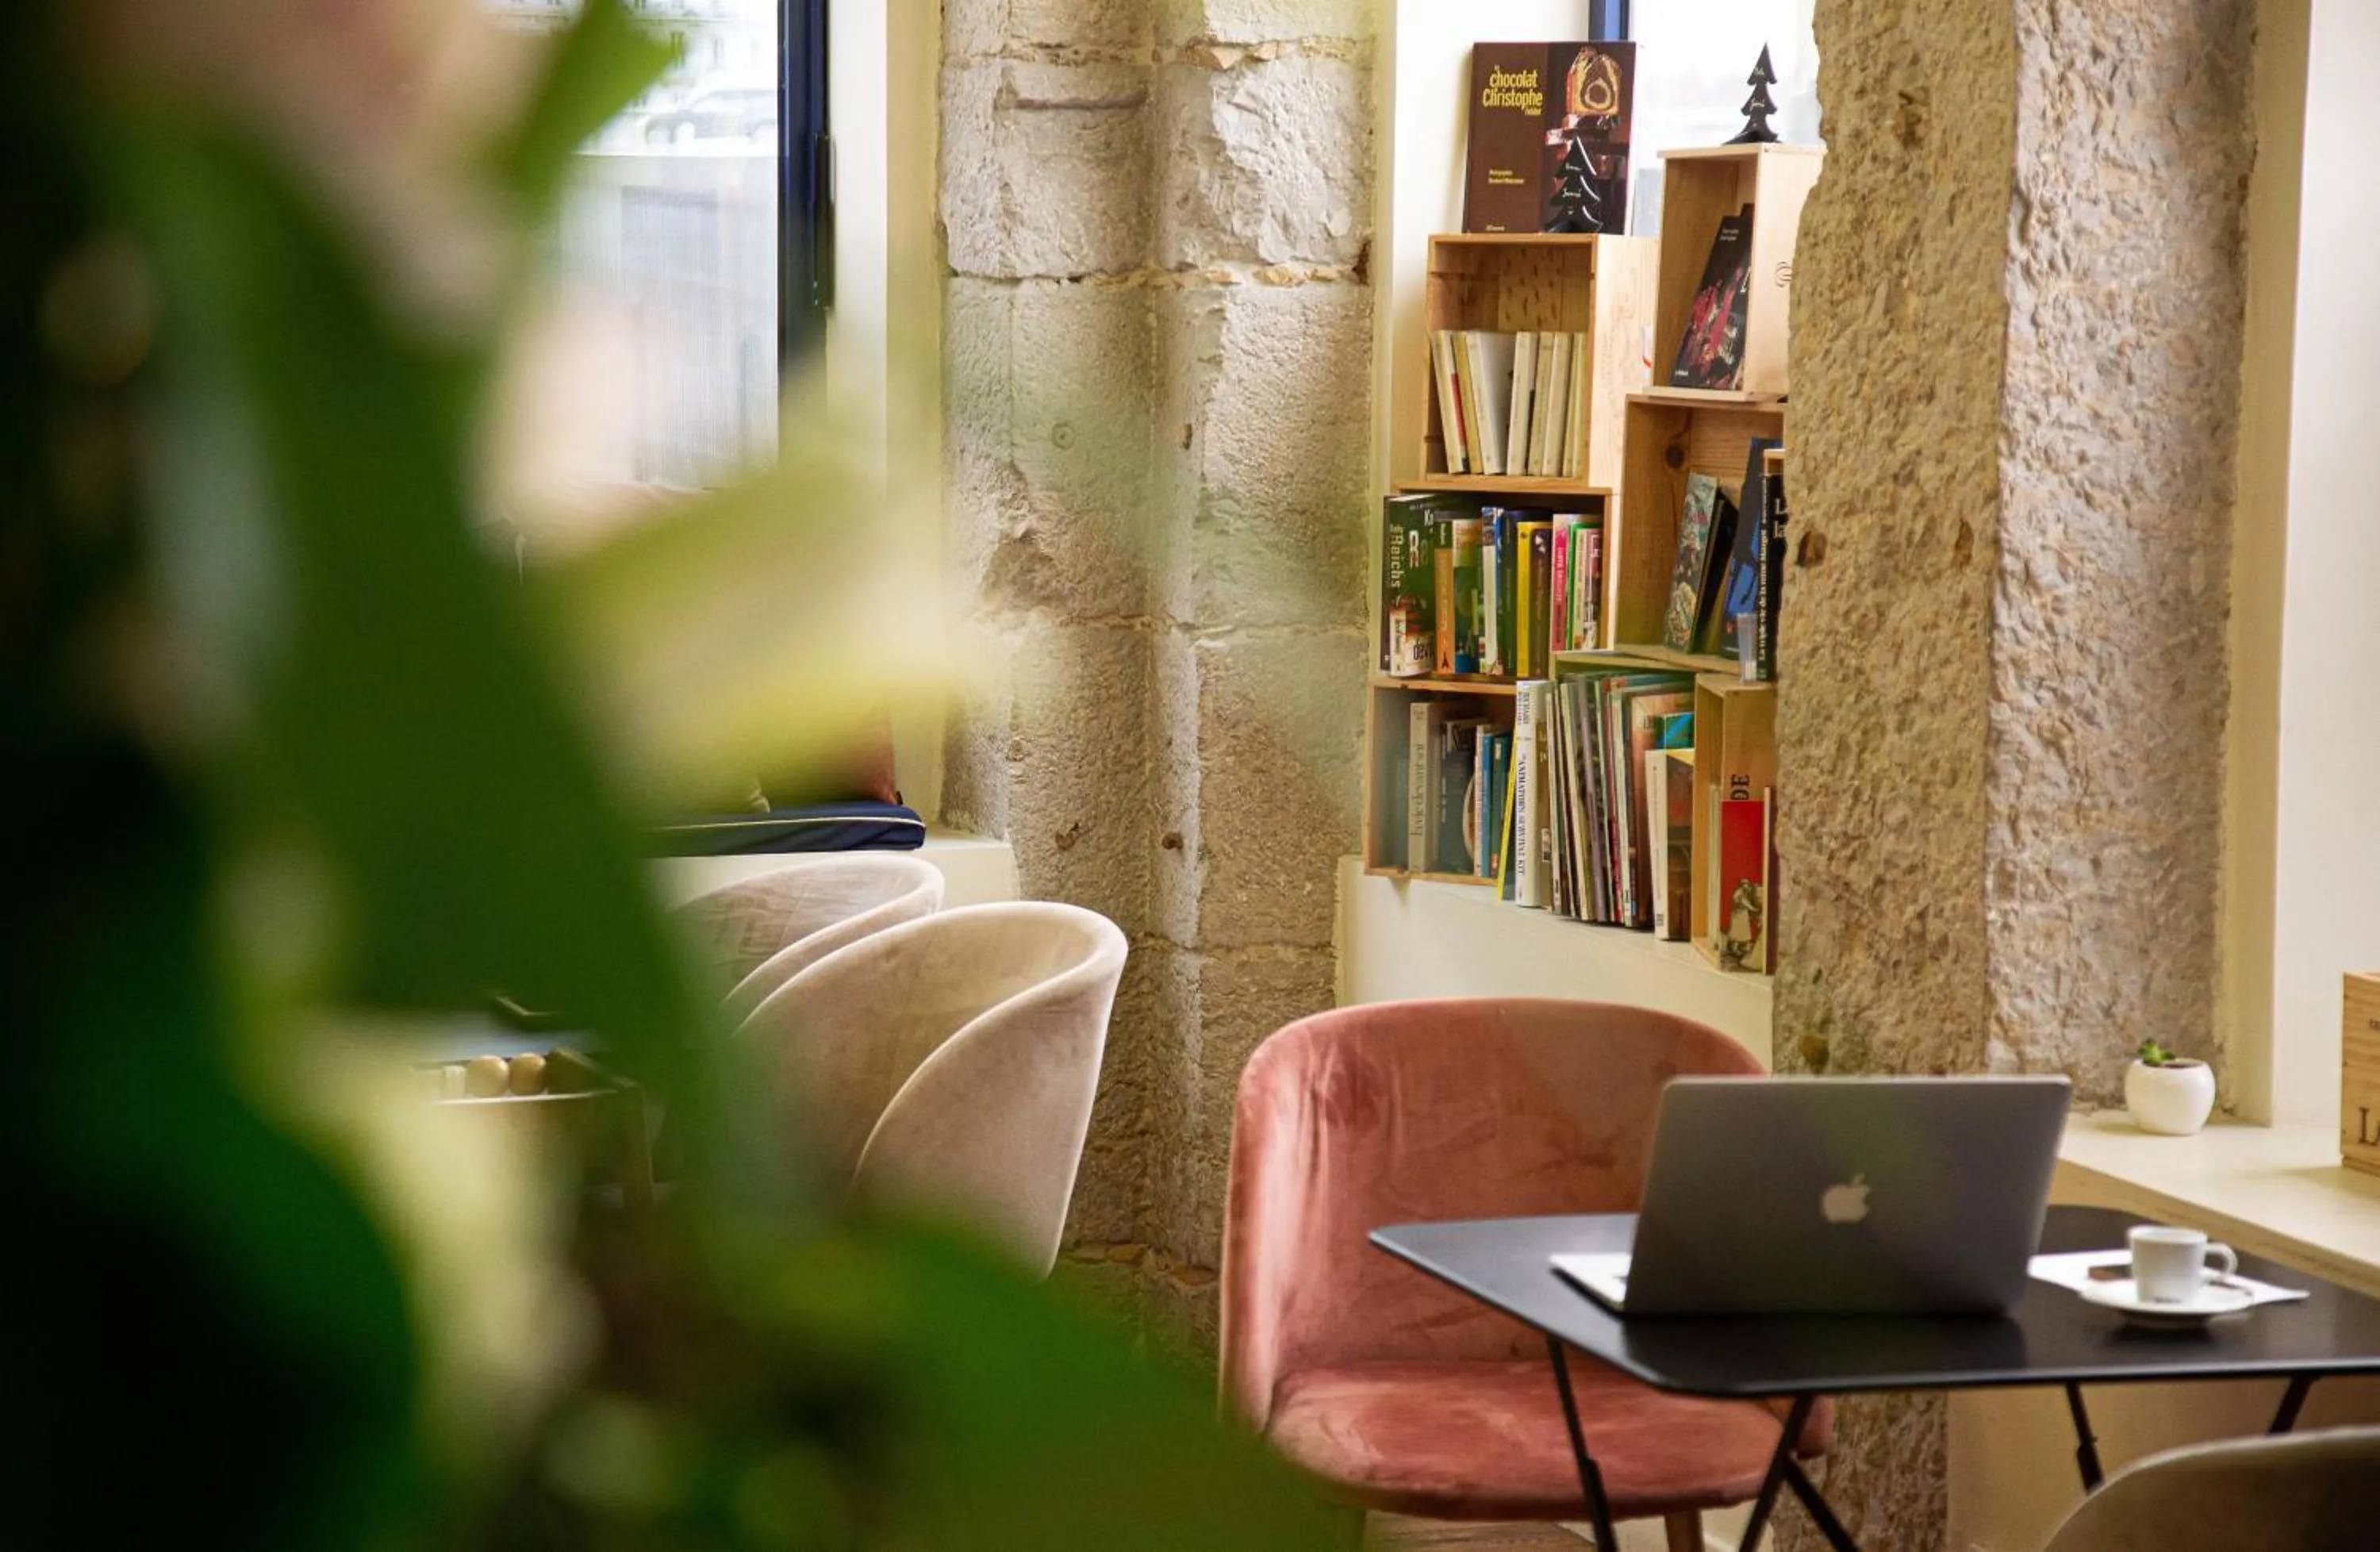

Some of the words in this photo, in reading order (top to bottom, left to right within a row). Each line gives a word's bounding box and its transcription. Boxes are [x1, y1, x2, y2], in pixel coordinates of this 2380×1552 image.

[1490, 69, 1537, 87] chocolat
[1482, 87, 1543, 109] Christophe
[1390, 532, 1405, 589] Reichs
[2358, 1106, 2380, 1147] L
